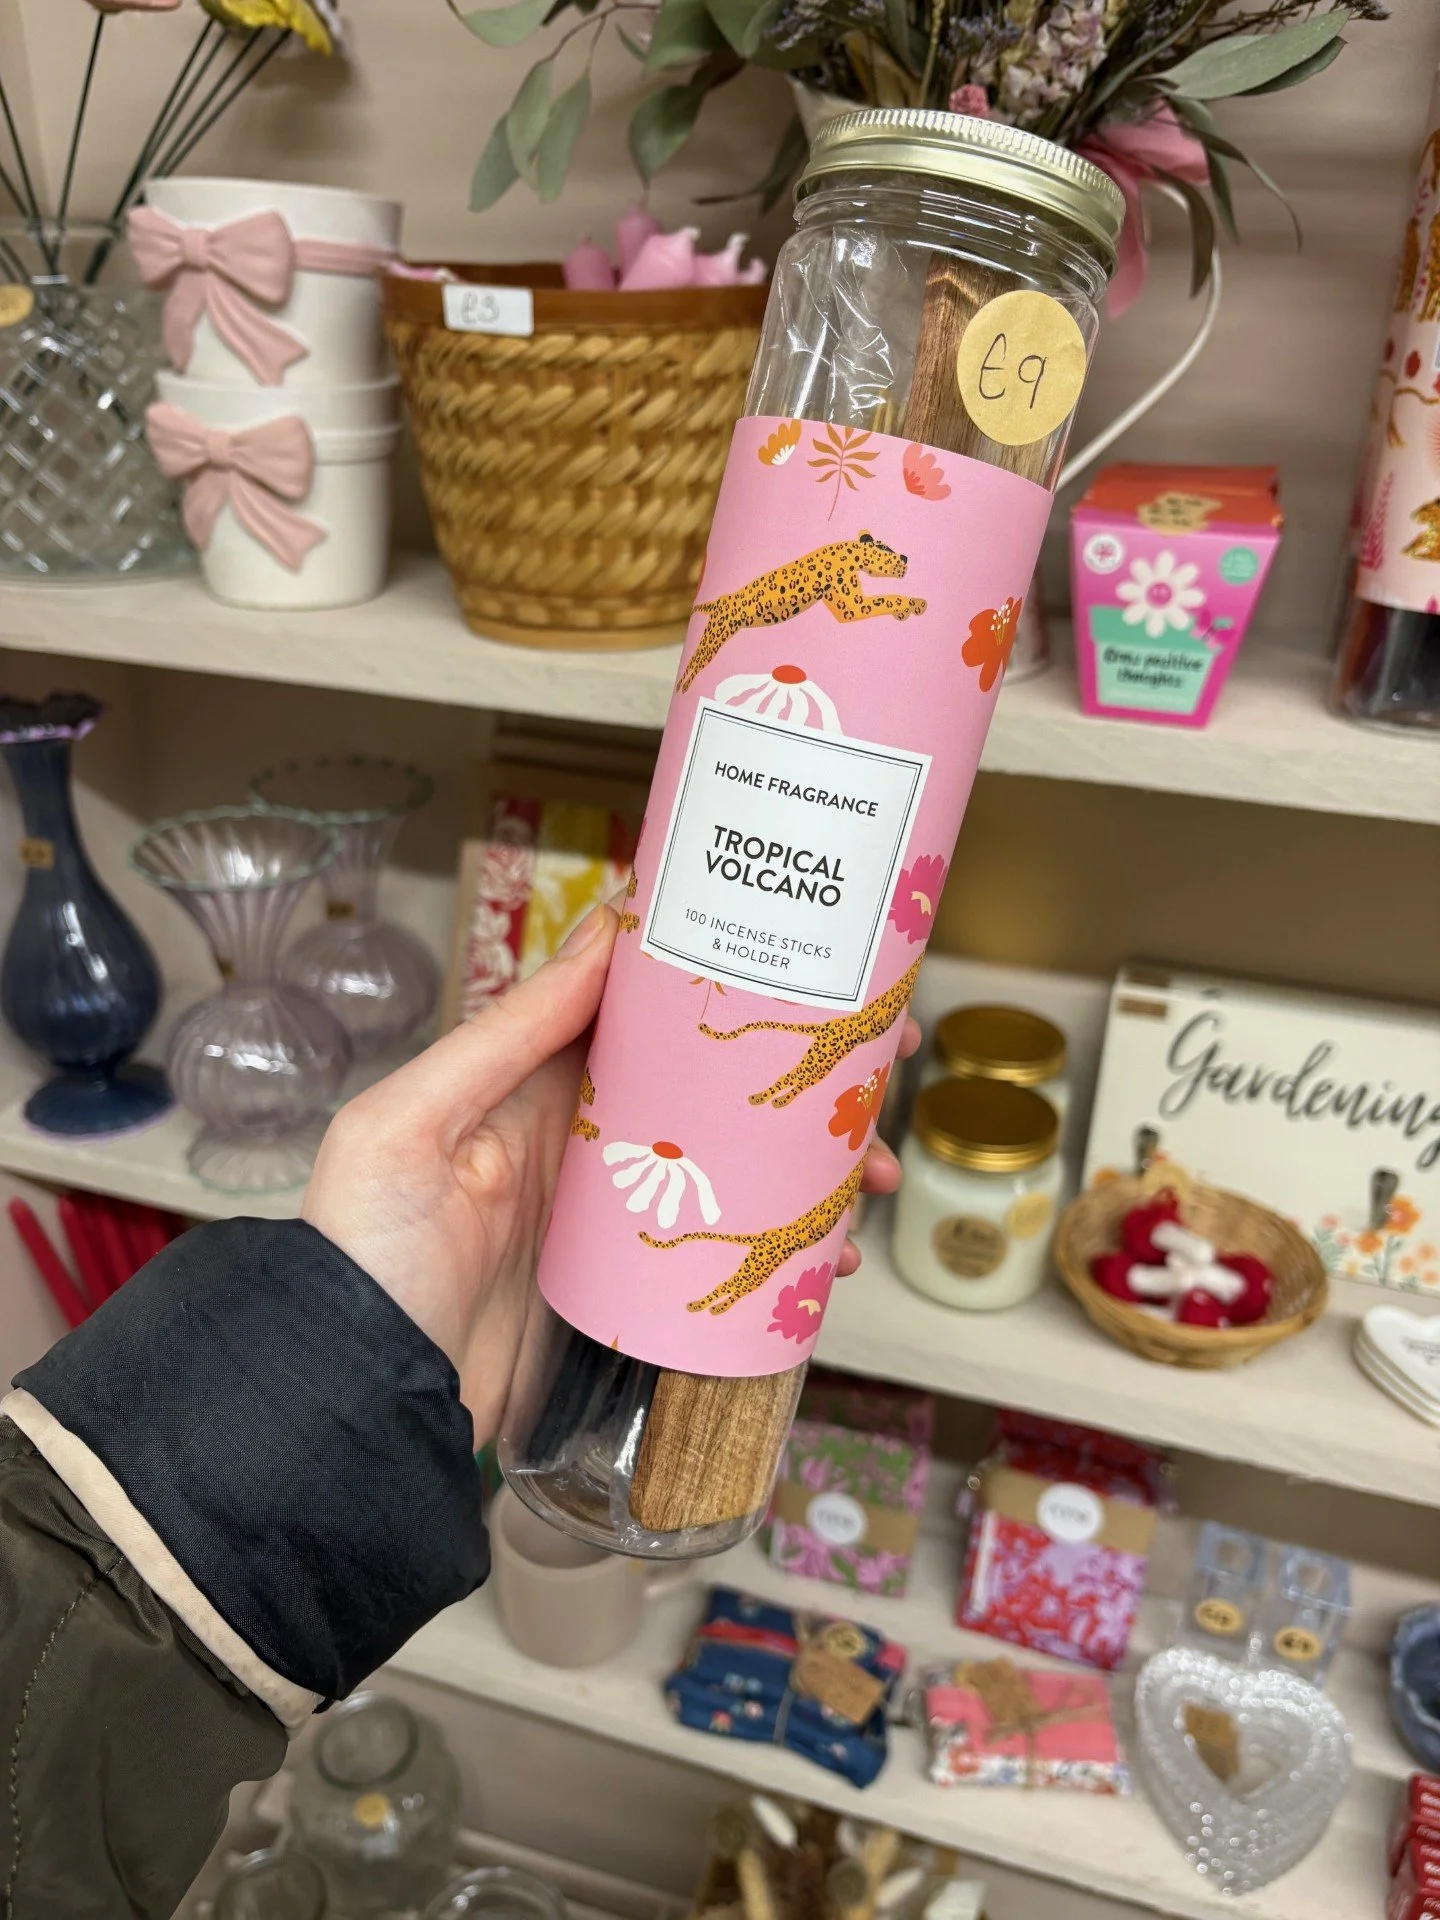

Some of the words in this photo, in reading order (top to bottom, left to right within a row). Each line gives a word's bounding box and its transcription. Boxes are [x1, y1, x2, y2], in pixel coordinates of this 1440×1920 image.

[978, 332, 1048, 410] £9
[1142, 651, 1204, 673] positive
[714, 761, 765, 788] HOME
[767, 777, 879, 817] FRAGRANCE
[706, 851, 841, 907] VOLCANO
[714, 825, 845, 882] TROPICAL
[684, 907, 708, 926] 100
[709, 916, 777, 948] INCENSE
[780, 936, 833, 960] STICKS
[711, 937, 722, 951] &
[725, 941, 791, 970] HOLDER
